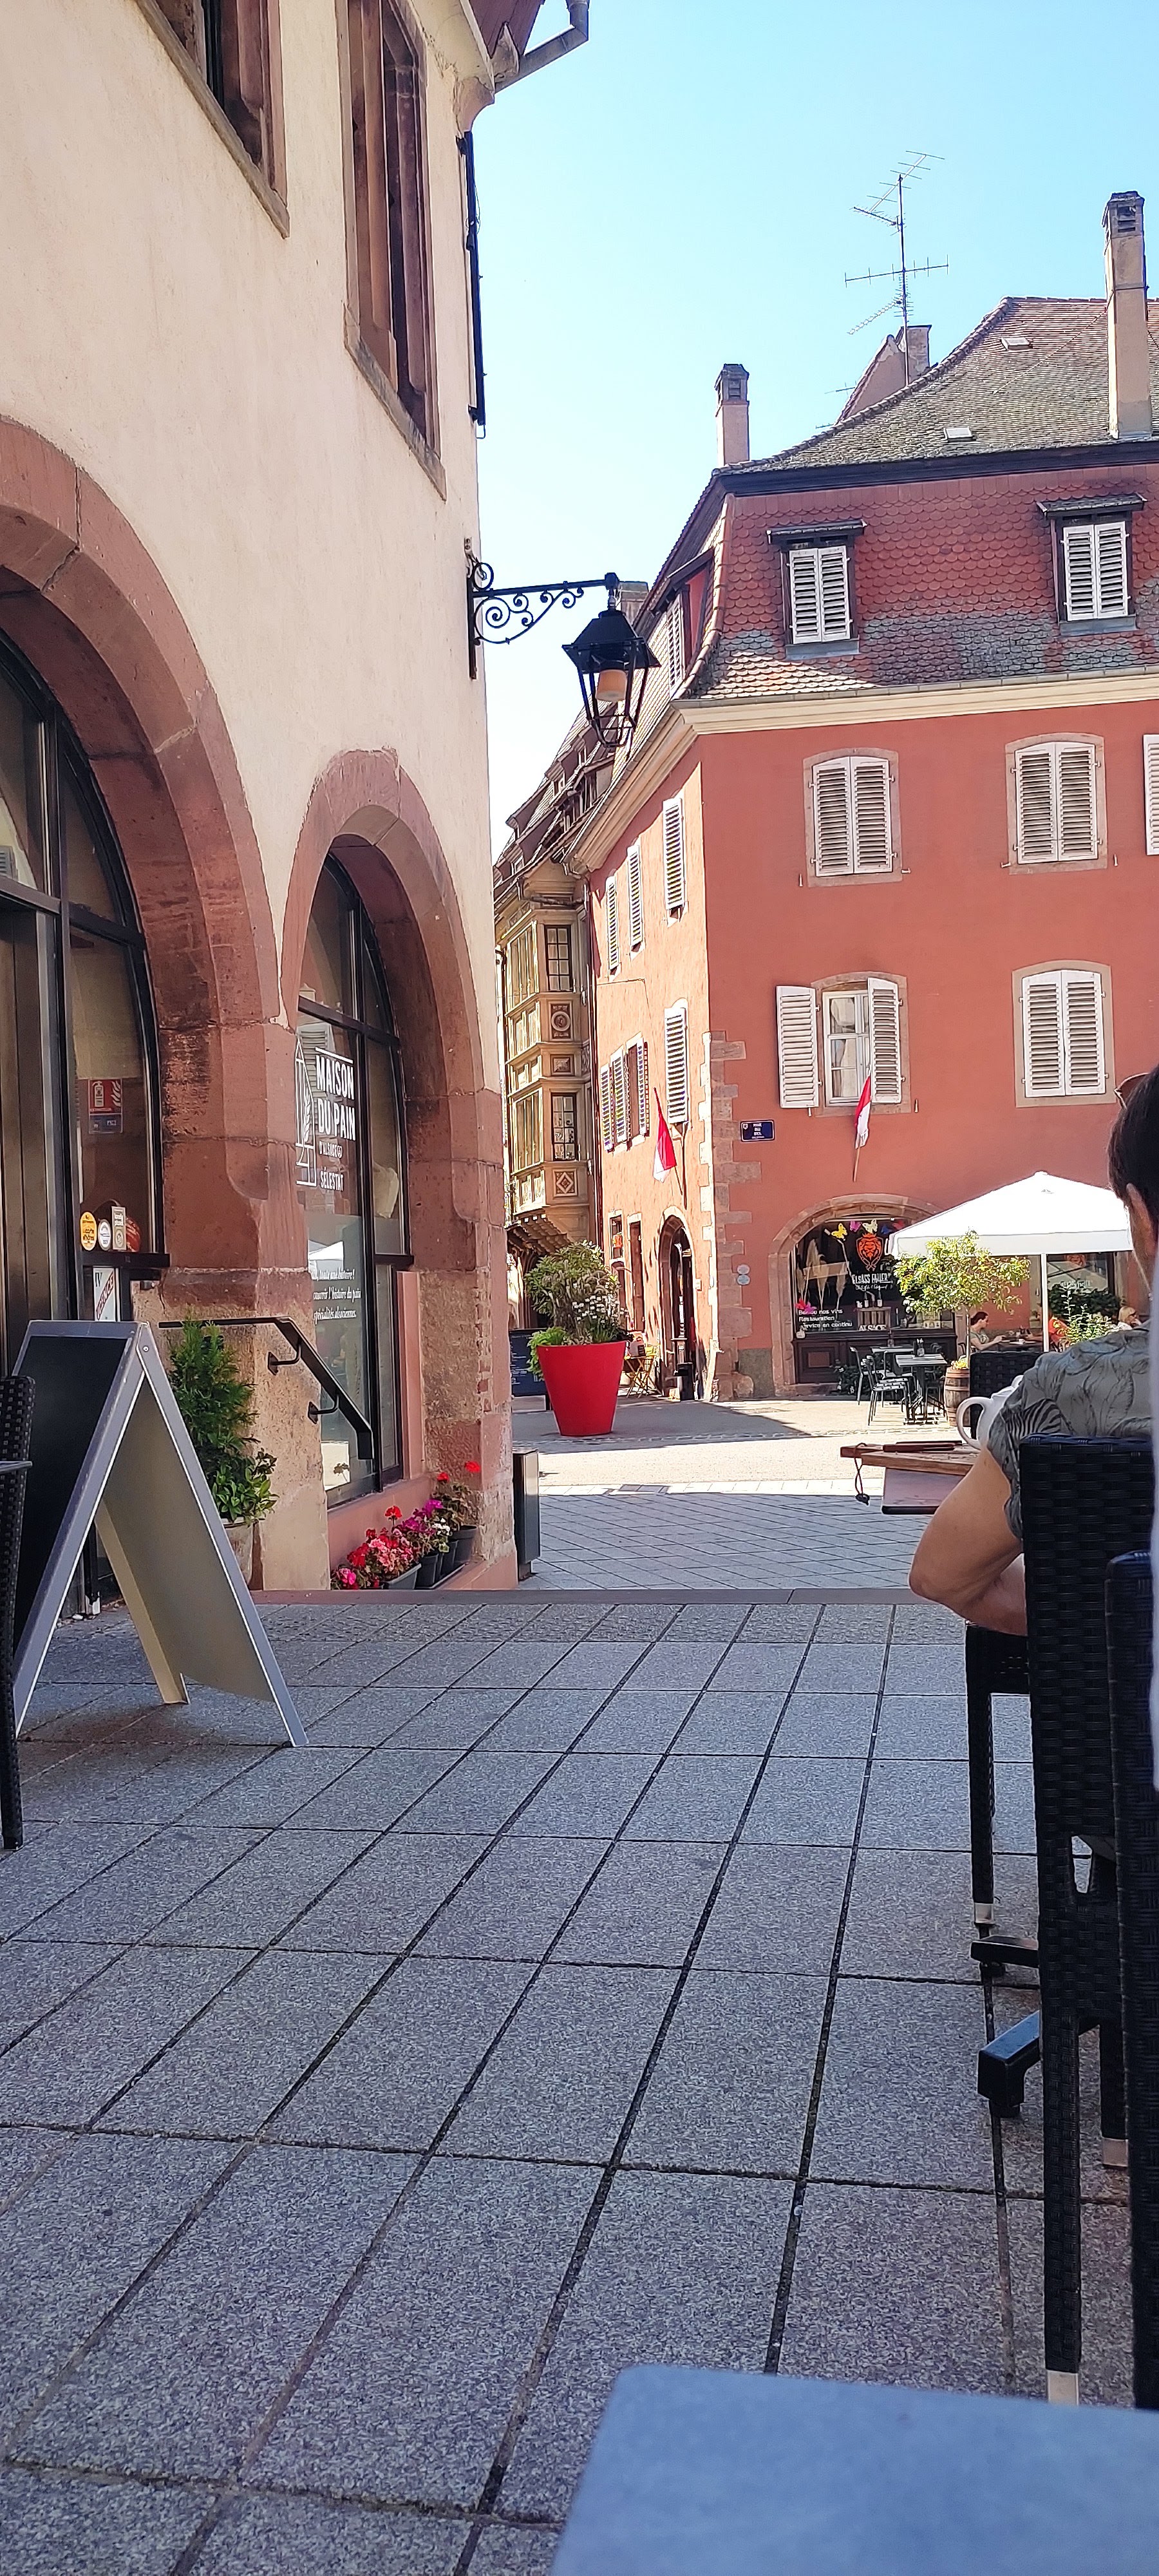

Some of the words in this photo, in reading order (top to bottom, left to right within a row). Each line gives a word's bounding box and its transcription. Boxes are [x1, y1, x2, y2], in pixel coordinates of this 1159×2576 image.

[316, 1055, 354, 1100] MAISON
[317, 1098, 331, 1135] DU
[334, 1103, 356, 1141] PAIN
[319, 1141, 337, 1158] D'ALSACE
[320, 1167, 344, 1191] SÉLESTAT
[95, 1273, 102, 1287] IV
[346, 1286, 352, 1298] du
[352, 1288, 361, 1302] pain
